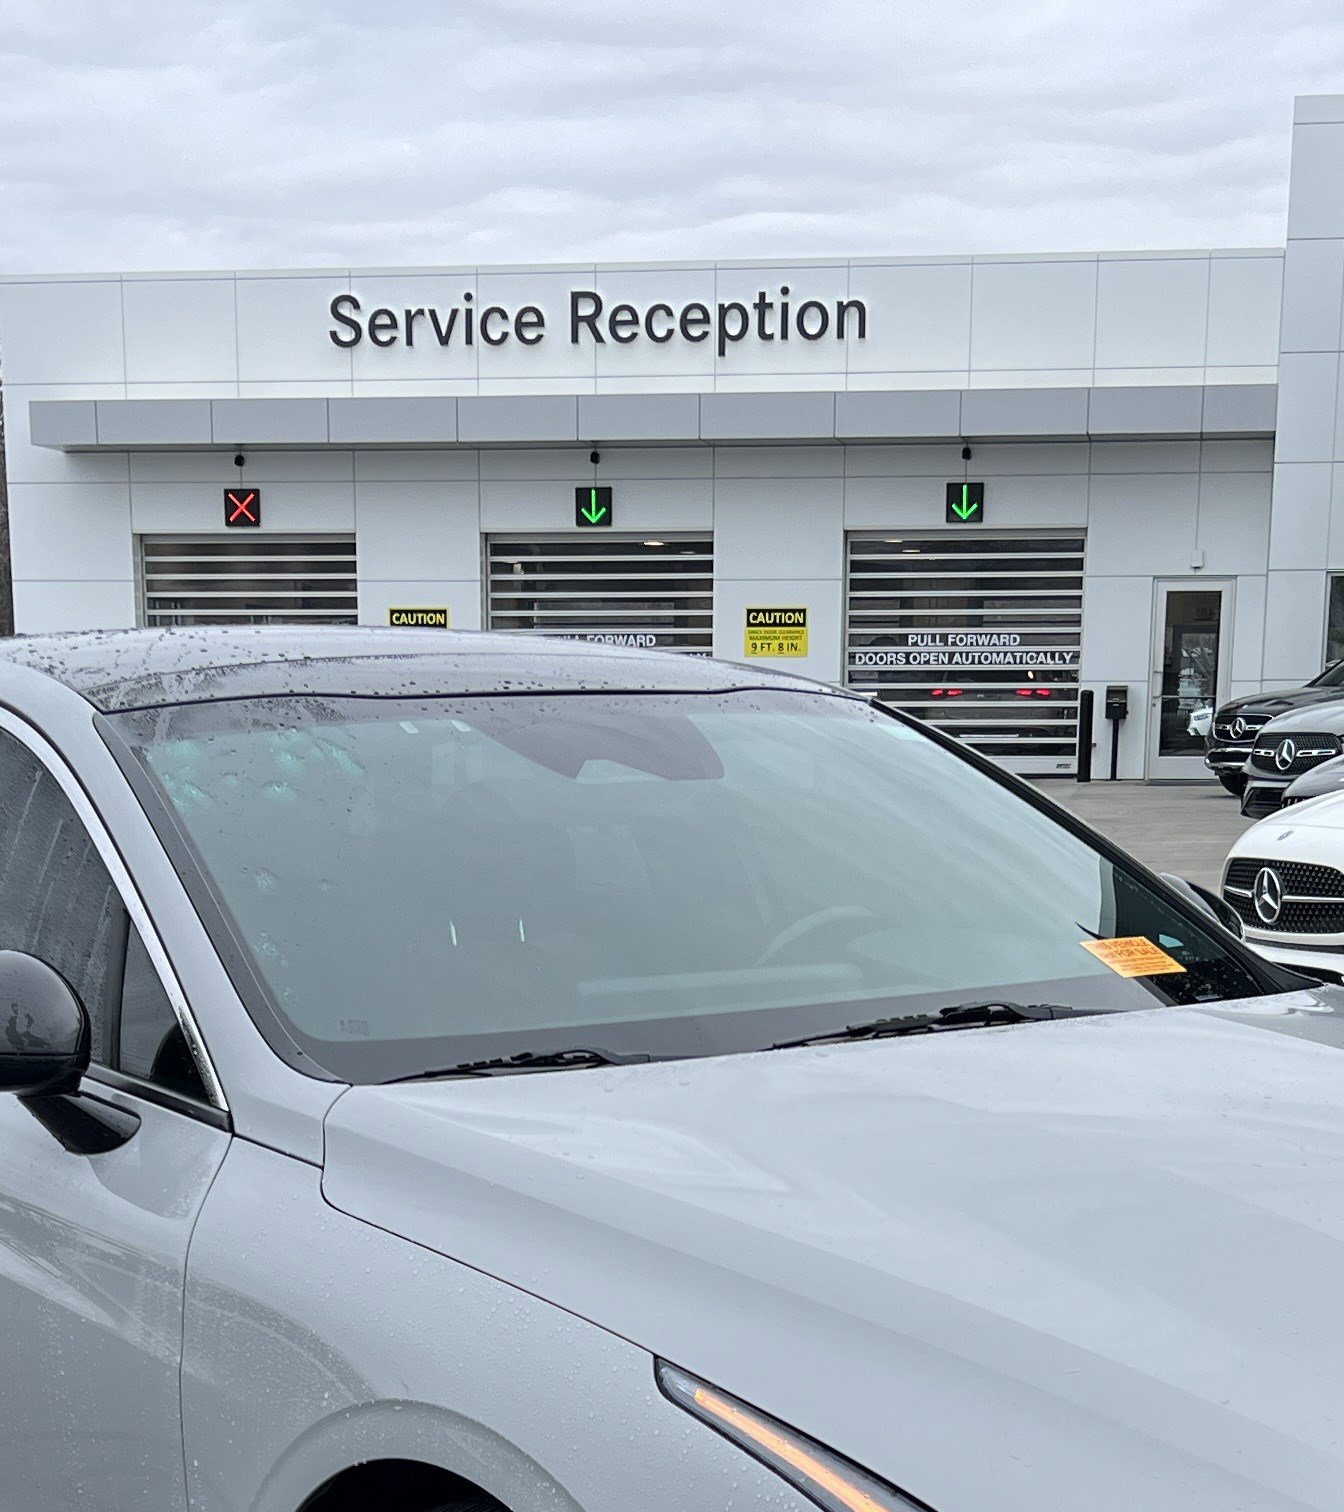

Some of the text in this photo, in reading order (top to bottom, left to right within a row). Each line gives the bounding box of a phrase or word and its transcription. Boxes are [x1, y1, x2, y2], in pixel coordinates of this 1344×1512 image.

[329, 286, 866, 357] Service Reception
[392, 612, 445, 625] CAUTION
[749, 611, 804, 624] CAUTION
[907, 634, 1021, 646] PULL FORWARD
[751, 642, 758, 652] 9
[777, 642, 784, 651] 8
[855, 650, 1074, 665] DOORS OPEN AUTOMATICALLY
